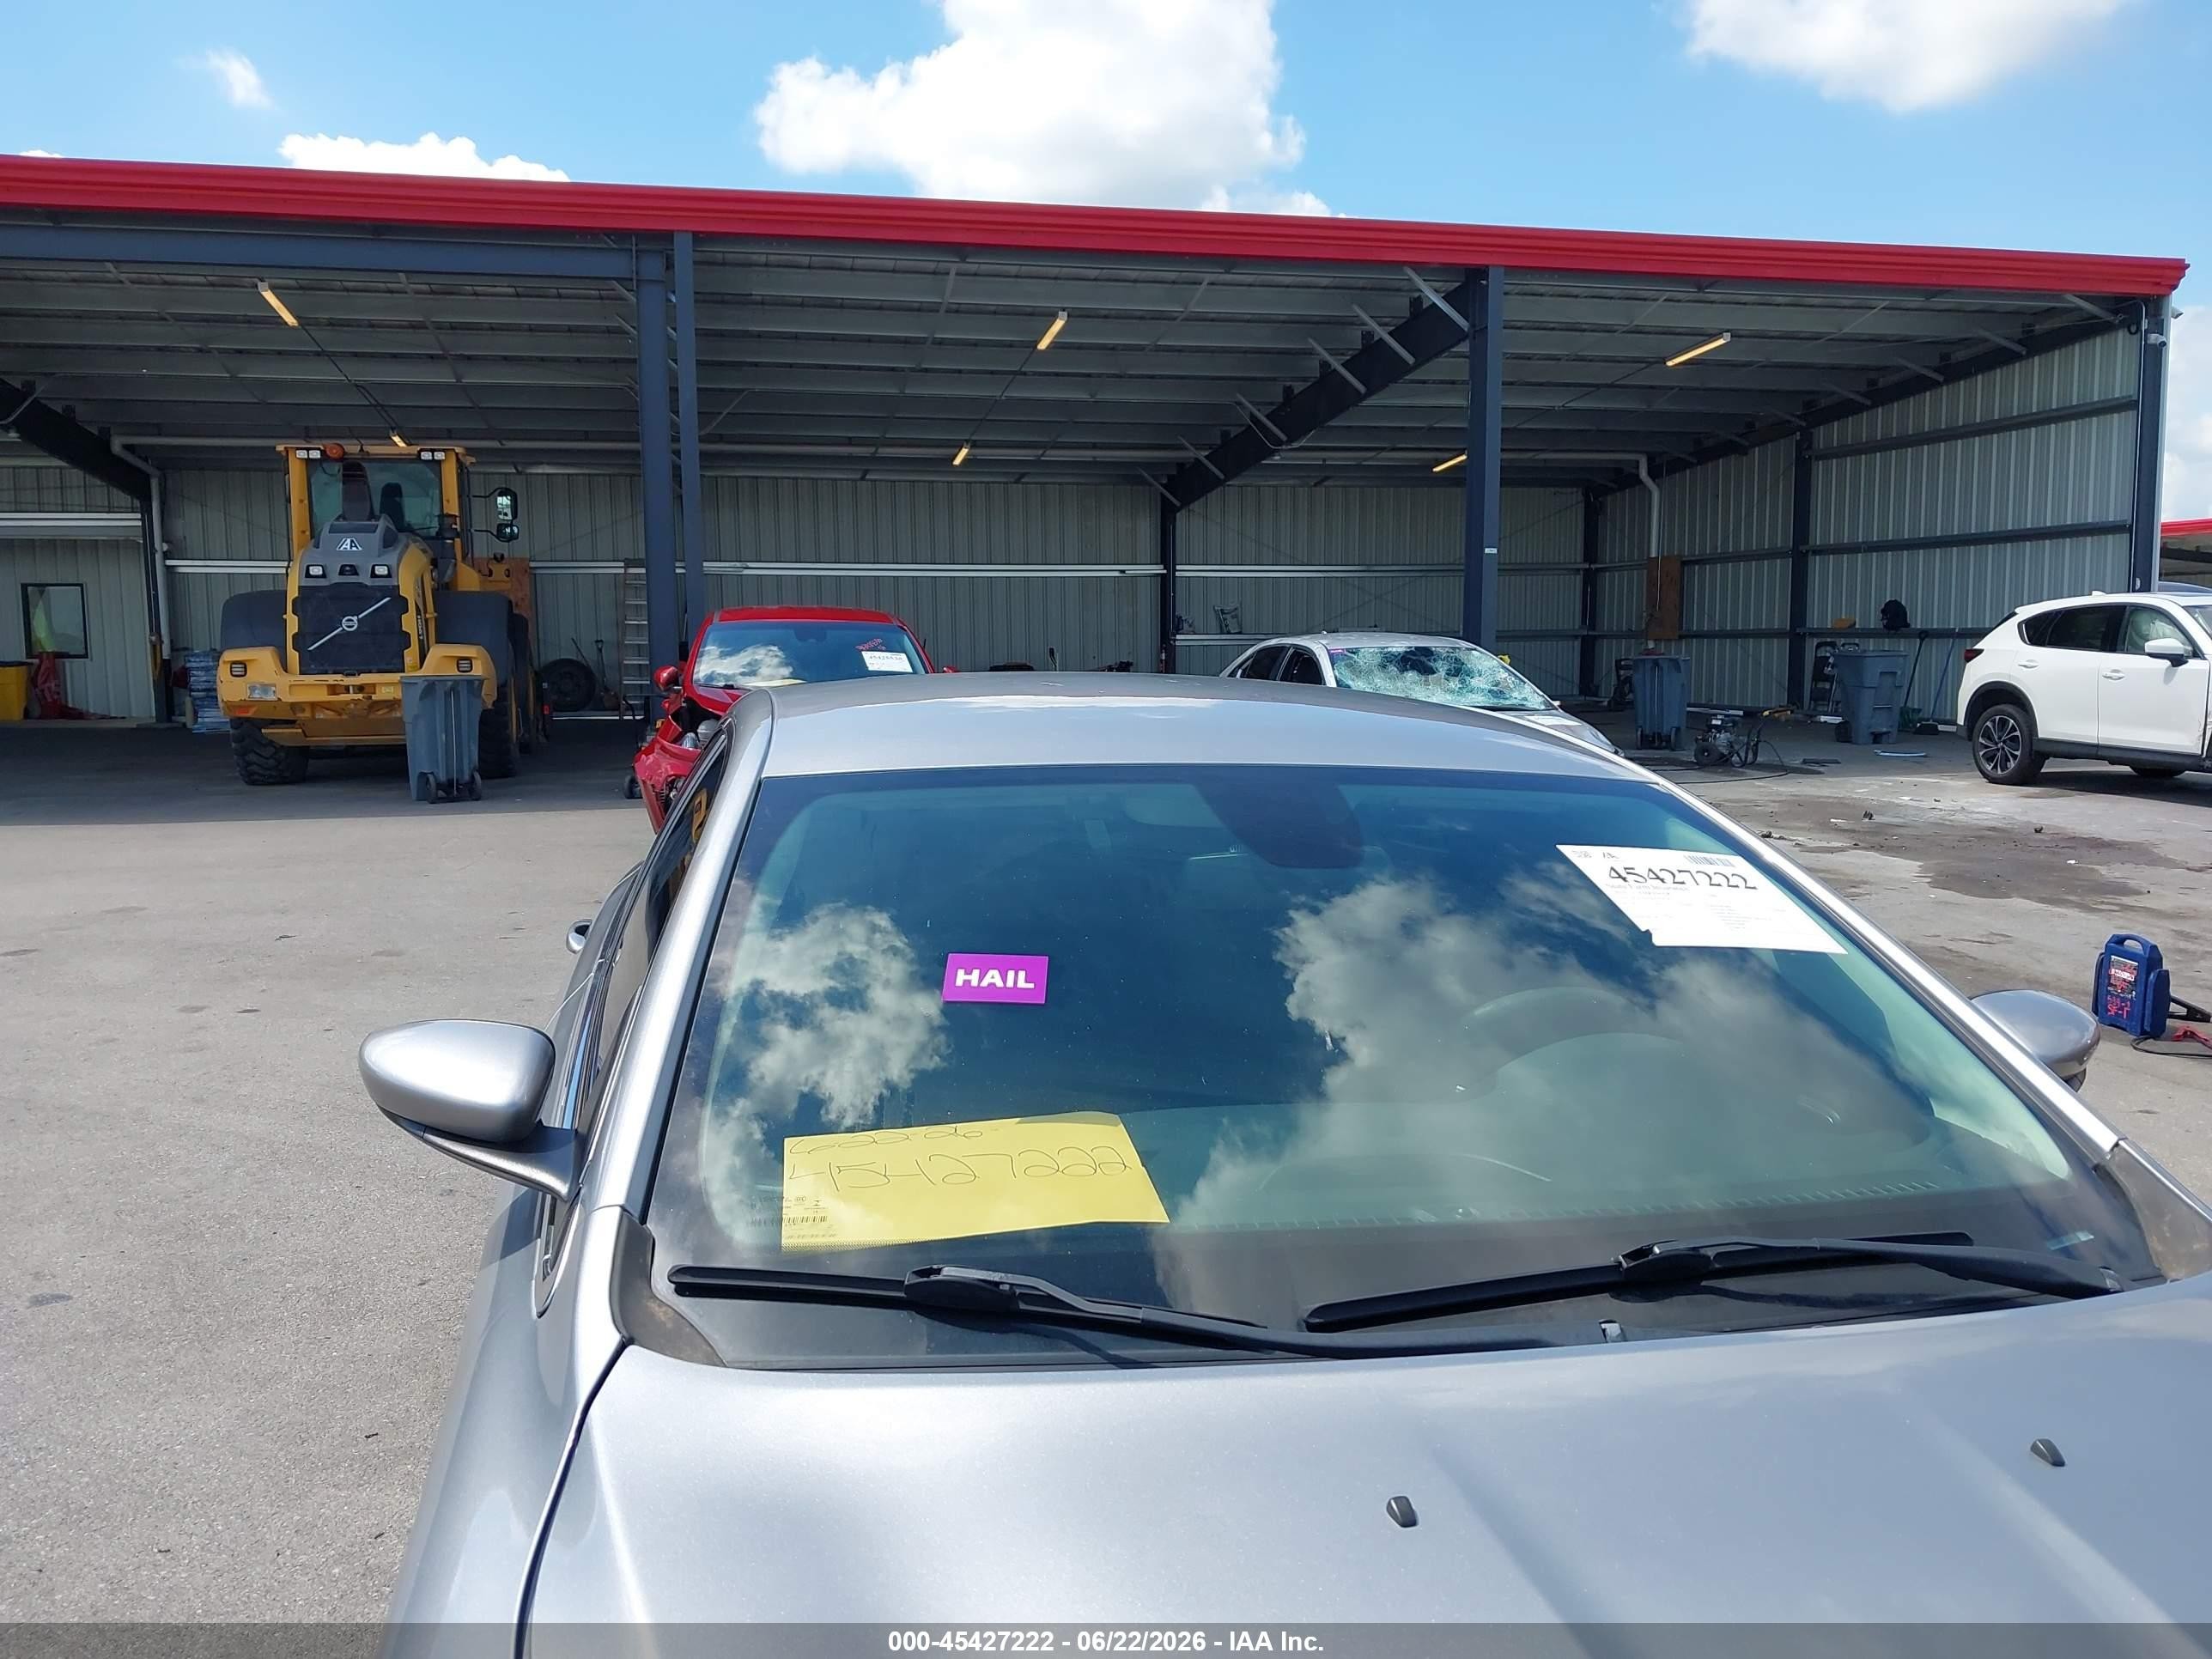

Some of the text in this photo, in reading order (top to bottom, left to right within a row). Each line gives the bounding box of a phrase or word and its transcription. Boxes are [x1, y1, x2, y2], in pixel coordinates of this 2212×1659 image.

[1607, 866, 1759, 890] 45427222
[955, 969, 1036, 989] HAIL
[789, 1146, 1133, 1192] 45427222
